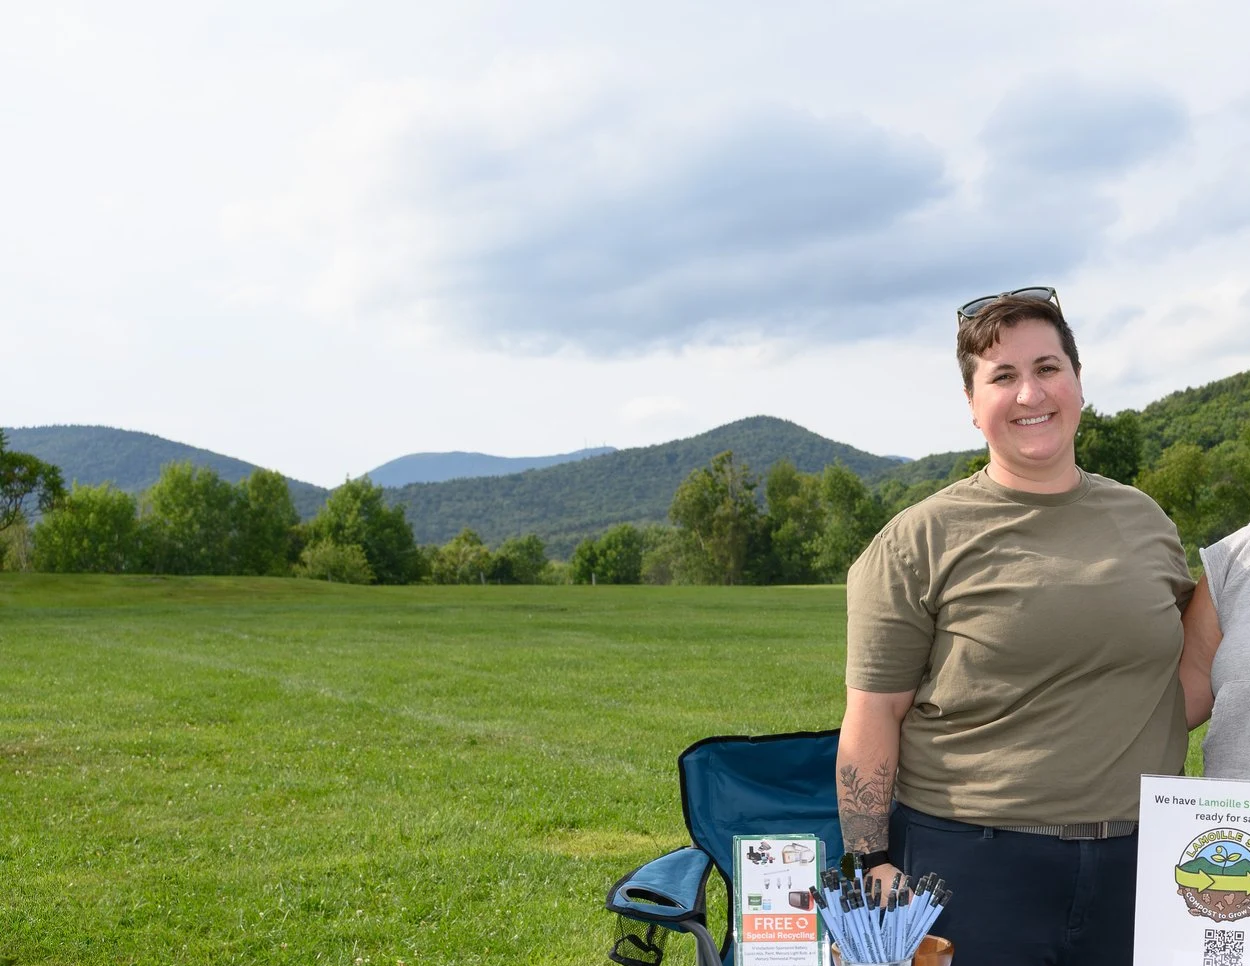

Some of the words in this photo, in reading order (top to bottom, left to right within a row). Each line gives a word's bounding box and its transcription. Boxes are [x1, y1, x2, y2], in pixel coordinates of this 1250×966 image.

[1154, 795, 1170, 804] We
[1172, 796, 1196, 806] have
[1198, 797, 1241, 809] Lamoille
[1195, 812, 1224, 823] ready
[1226, 813, 1241, 822] for
[1186, 830, 1244, 858] LAMOILLE
[1185, 891, 1218, 917] COMPOST
[1228, 908, 1248, 919] Grow
[754, 917, 793, 930] FREE
[746, 932, 776, 940] Special
[777, 932, 816, 941] Recycling
